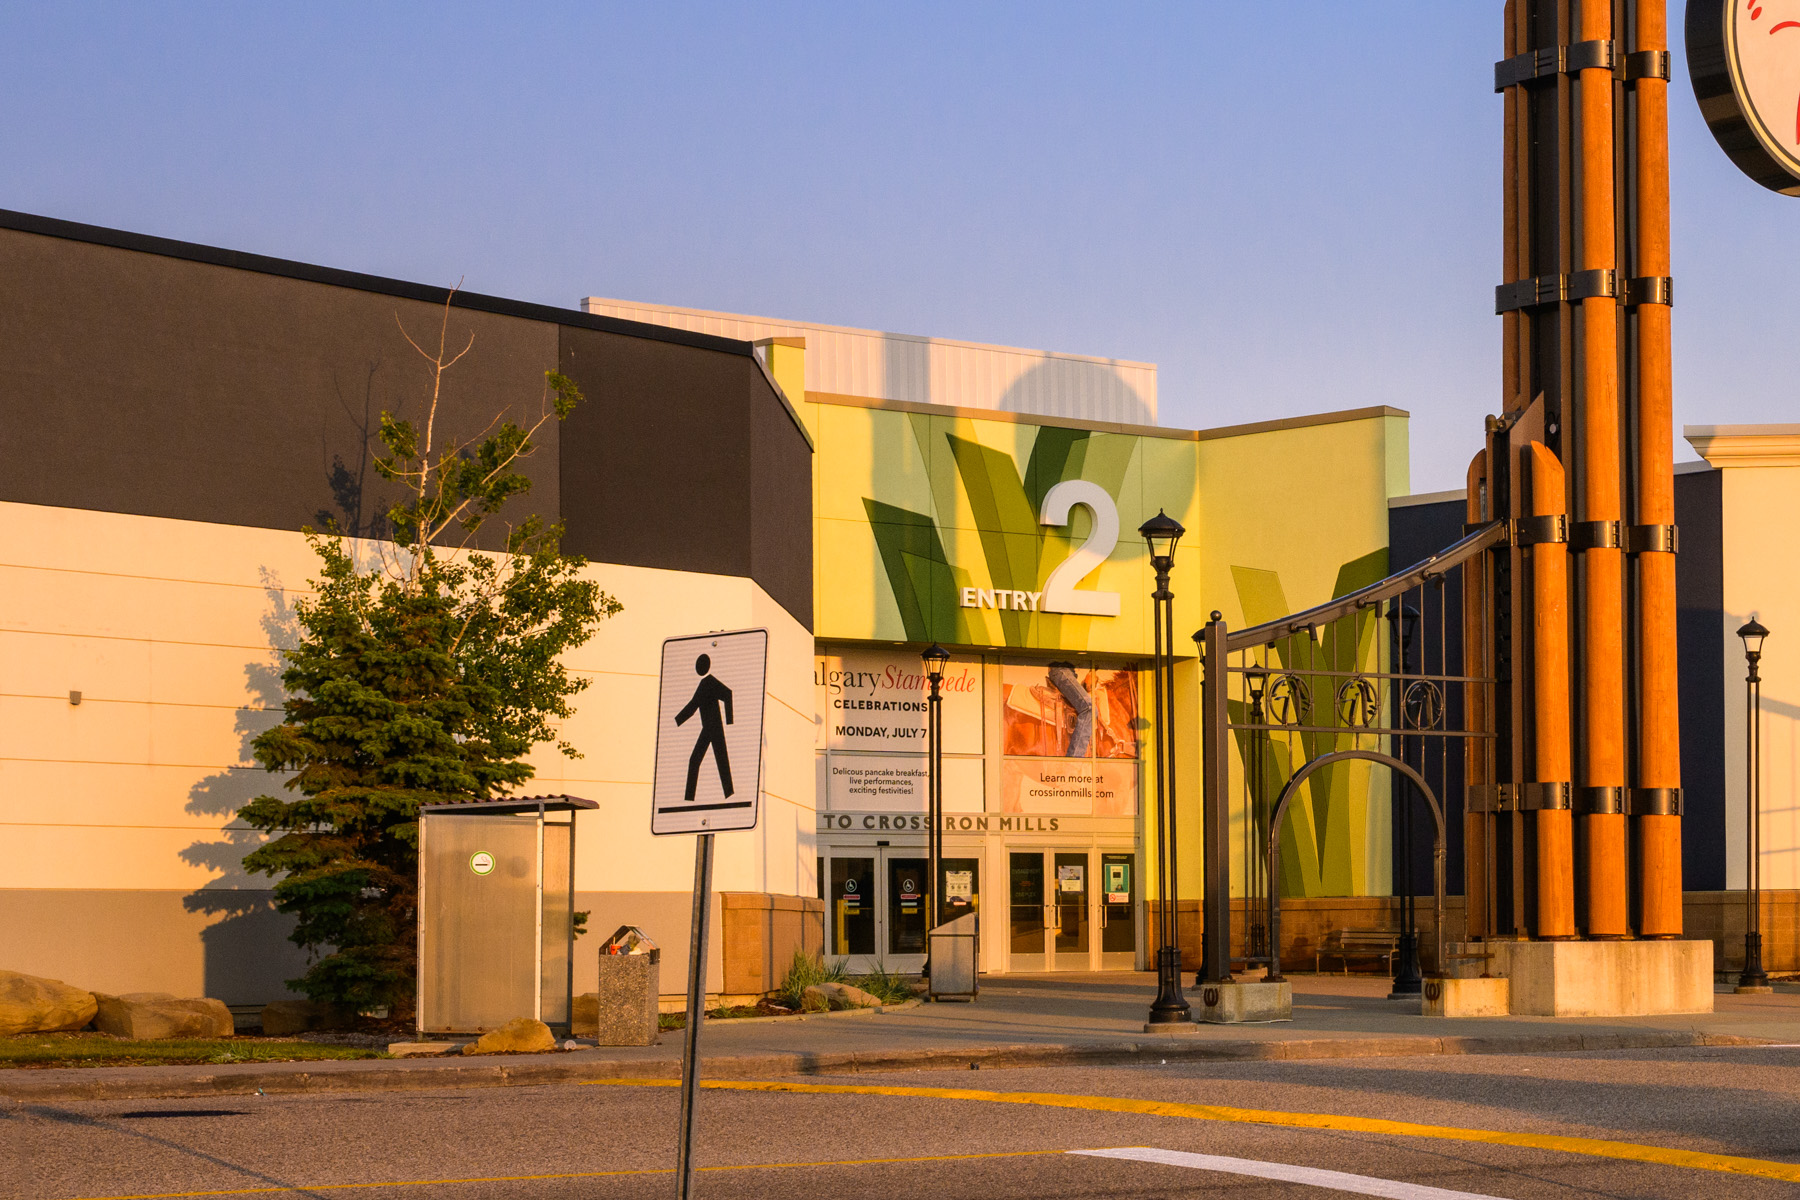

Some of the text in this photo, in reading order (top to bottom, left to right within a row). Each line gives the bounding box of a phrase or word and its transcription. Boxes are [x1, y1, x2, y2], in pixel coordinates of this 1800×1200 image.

[960, 479, 1121, 617] ENTRY 2
[814, 661, 881, 696] lgary
[833, 699, 928, 712] CELEBRATIONS
[835, 725, 927, 739] MONDAY, JULY 7
[832, 767, 863, 776] Delicous
[864, 769, 894, 779] pancake
[1040, 772, 1104, 784] Learn more at
[849, 777, 914, 787] live performances,
[849, 786, 914, 796] exciting festivities!
[1029, 787, 1114, 799] crossironmillscom
[823, 814, 1059, 832] TO CROSSRON MILLS
